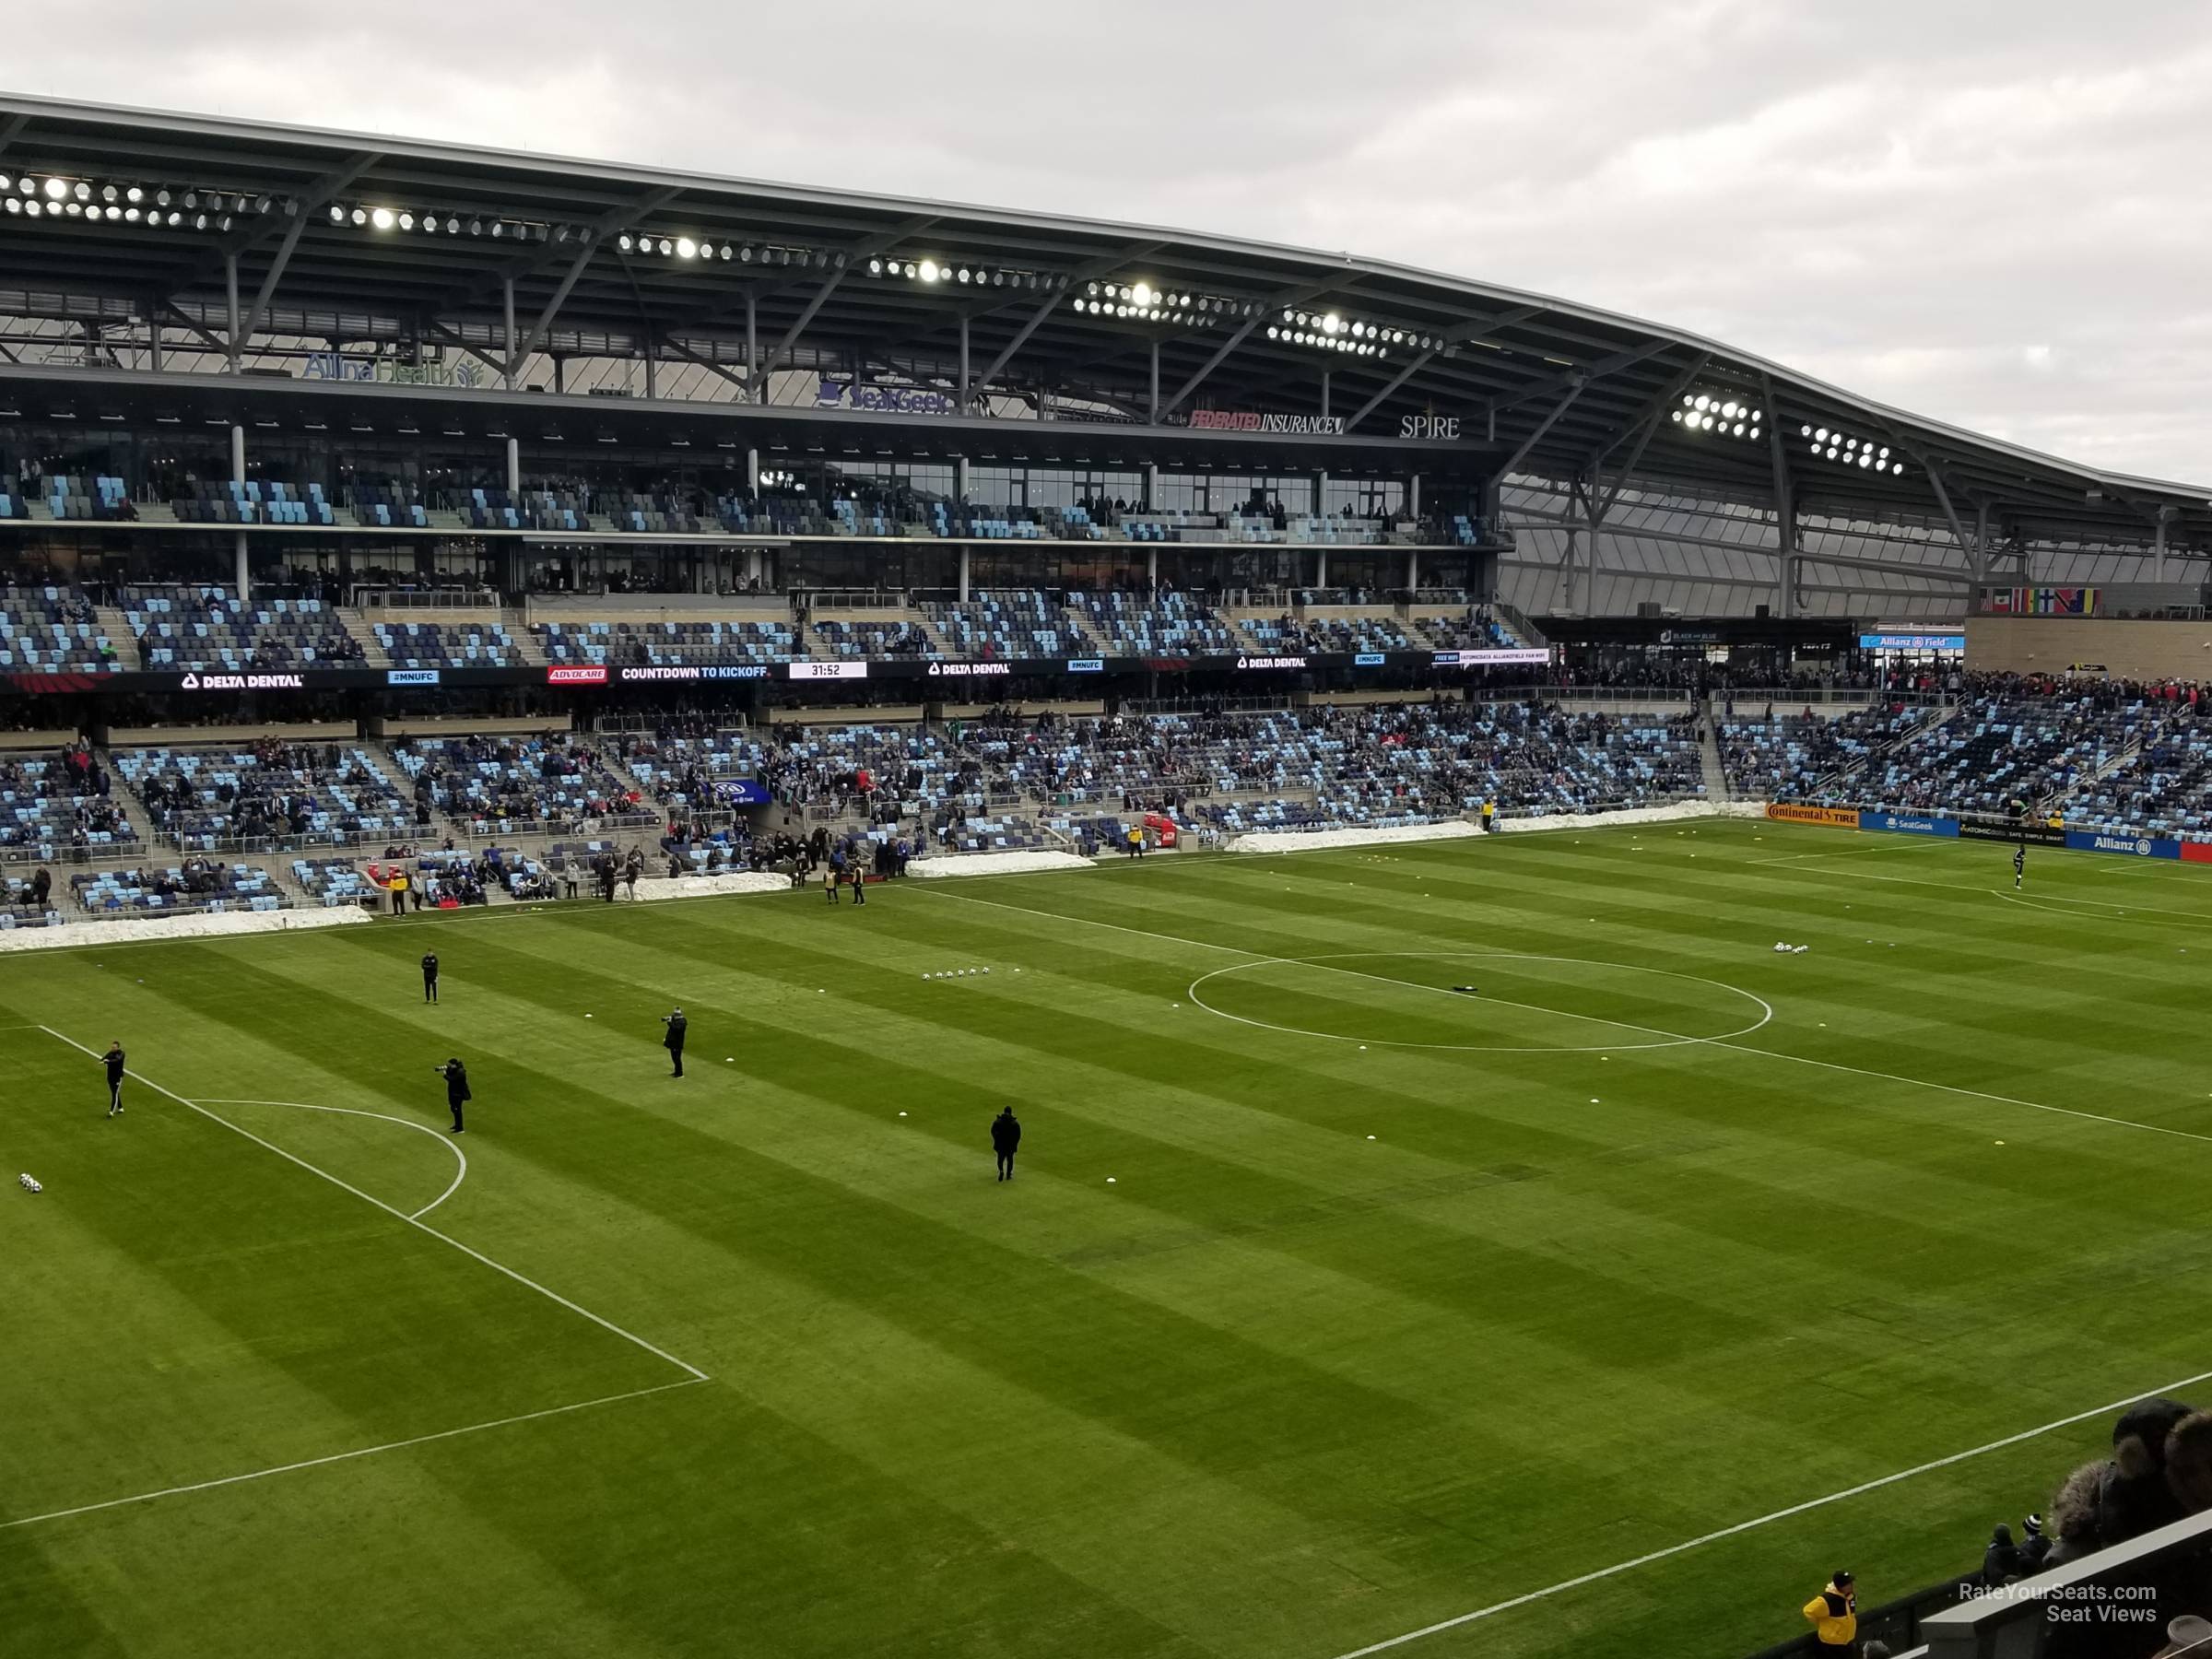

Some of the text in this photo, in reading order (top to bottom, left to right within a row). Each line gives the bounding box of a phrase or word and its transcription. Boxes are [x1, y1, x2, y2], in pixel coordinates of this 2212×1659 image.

[302, 354, 453, 386] Allina Health
[850, 386, 947, 413] SeatGeek
[1189, 410, 1335, 434] FEDERATED INSURANCE
[1400, 416, 1460, 438] SPIRE
[1880, 637, 1946, 646] Allianz Field
[1071, 661, 1100, 669] #MNUFC
[1249, 657, 1306, 668] DELTA DENTAL
[550, 669, 605, 680] ADVOCARE
[622, 666, 768, 679] COUNTDOWN TO KICKOFF
[812, 665, 840, 676] 31:52
[943, 663, 1010, 675] DELTA DENTAL
[203, 674, 302, 688] DELTA DENTAL
[394, 673, 433, 682] #MNUFC
[1769, 805, 1856, 824] Continental TIRE
[1899, 818, 1934, 830] SeatGeek
[2094, 836, 2135, 852] Allianz
